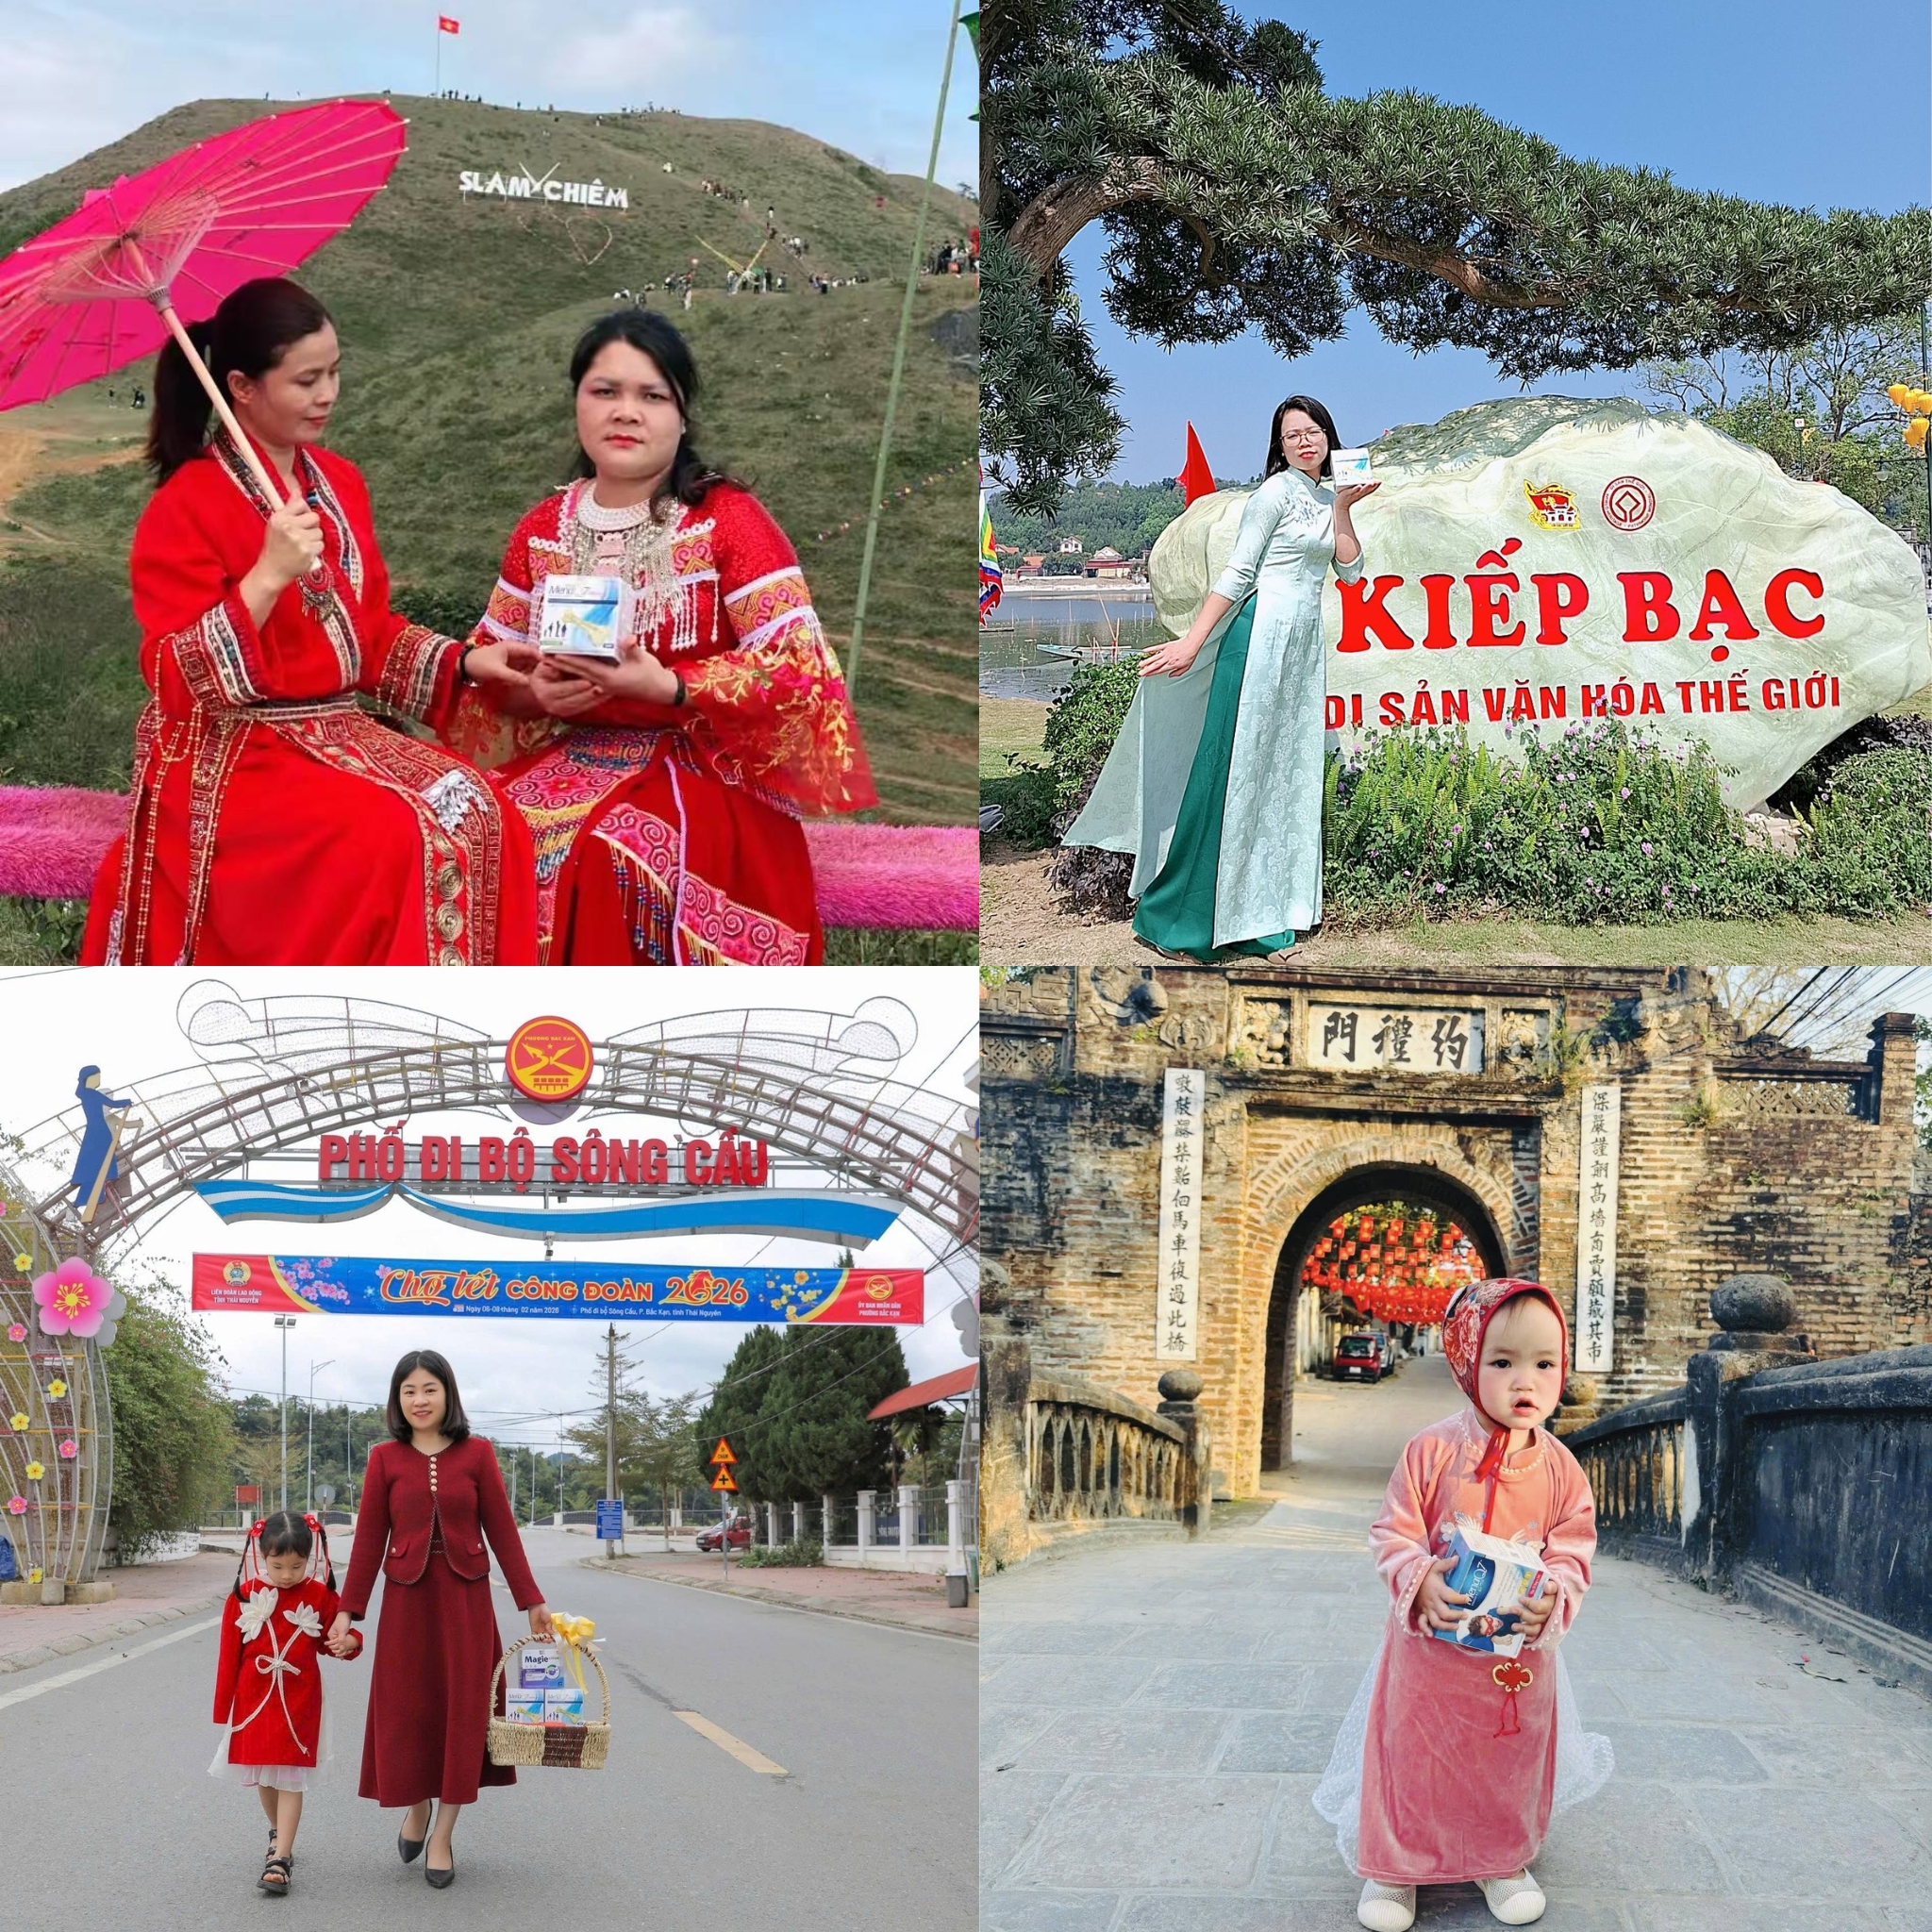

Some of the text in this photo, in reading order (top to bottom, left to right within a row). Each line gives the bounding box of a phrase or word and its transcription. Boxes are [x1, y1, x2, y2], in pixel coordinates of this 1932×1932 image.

[458, 171, 628, 208] SLAM CHIÊM
[1334, 537, 1825, 662] KIẾP BẠC
[1324, 668, 1840, 730] DI SẢN VĂN HÓA THẾ GIỚI
[319, 1120, 768, 1193] PHỐ ĐI BỘ SÔNG CẦU
[380, 1268, 749, 1307] Chợ tết CÔNG ĐOÀN 2026
[608, 1307, 624, 1316] Sông
[525, 1655, 548, 1664] Magie
